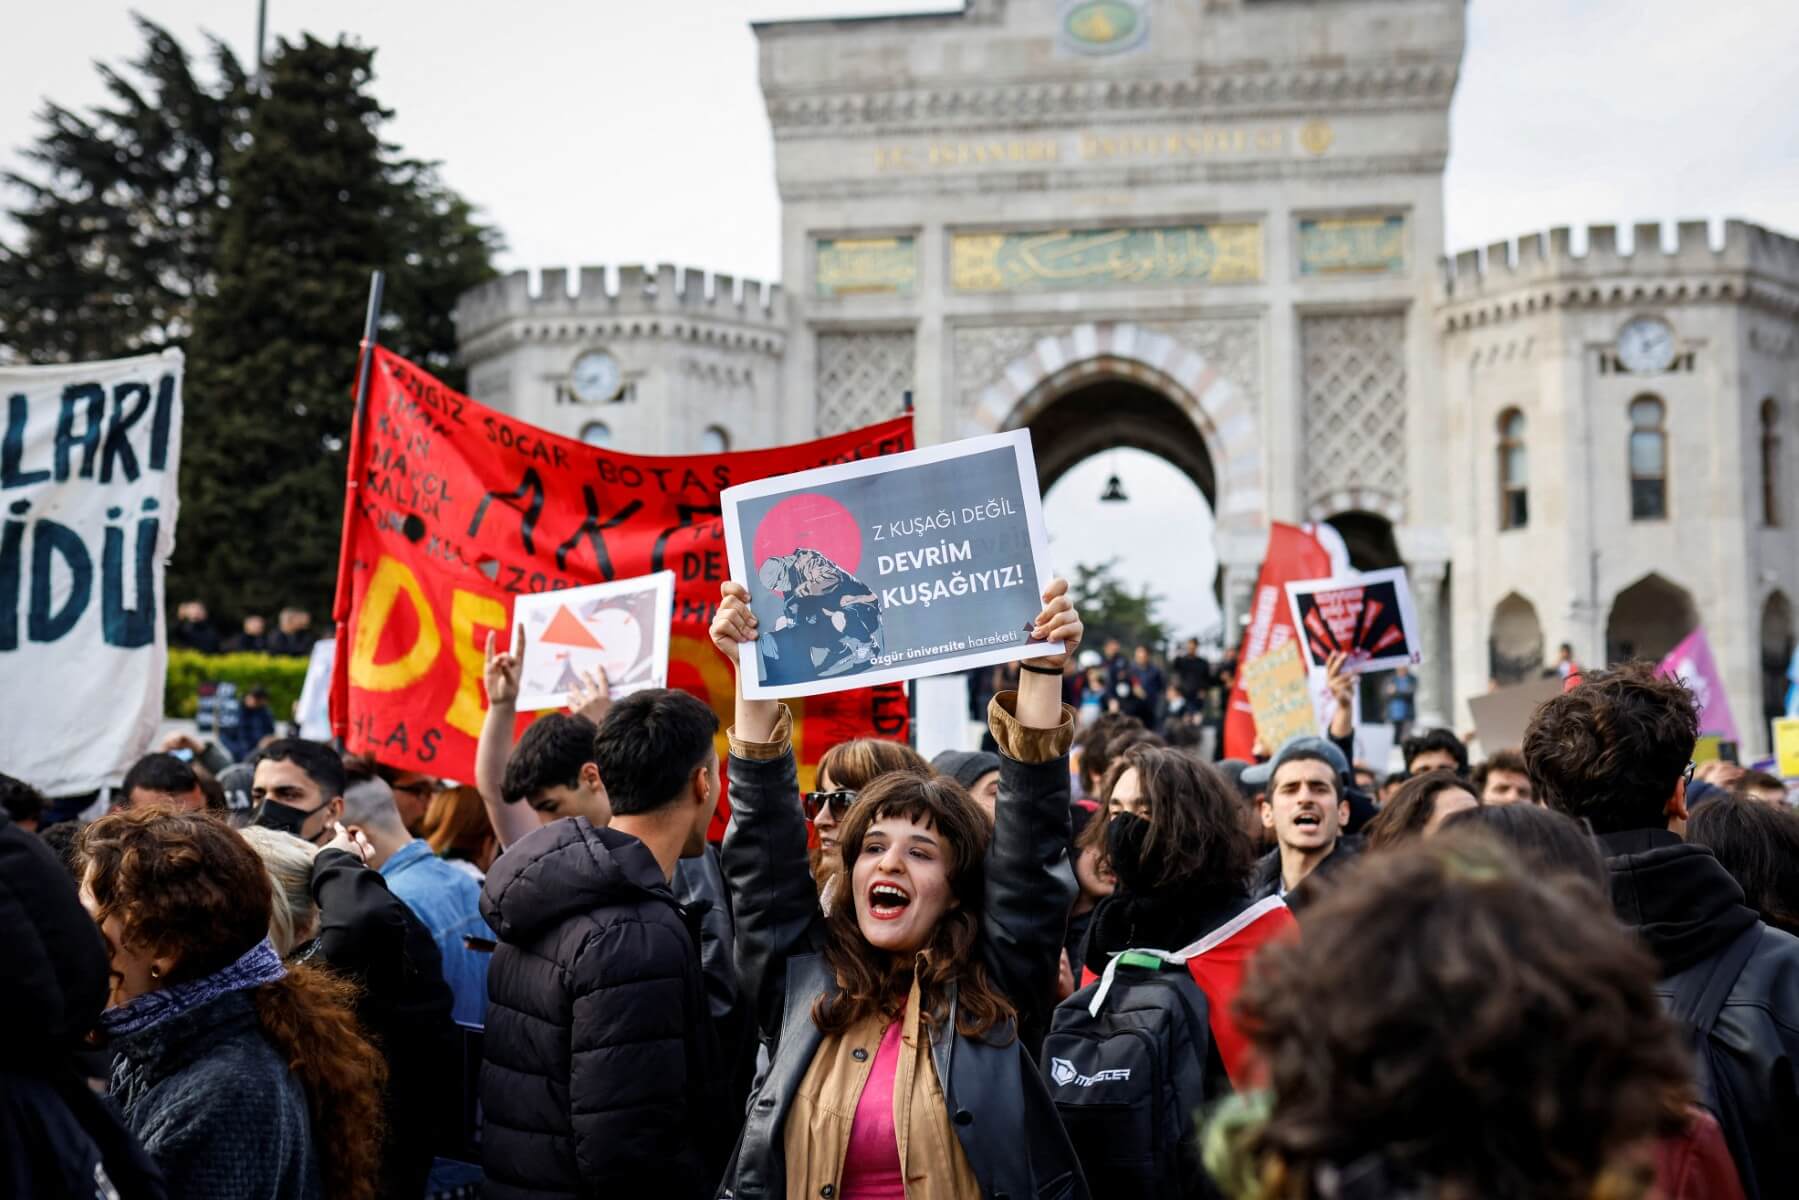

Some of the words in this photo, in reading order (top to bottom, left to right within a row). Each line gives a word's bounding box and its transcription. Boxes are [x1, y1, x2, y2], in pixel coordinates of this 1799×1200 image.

[1, 374, 175, 490] LARI
[483, 416, 572, 471] SOCAR
[873, 525, 885, 541] Z
[890, 510, 957, 537] KUŞAĞI
[961, 497, 1017, 524] DEĞİL
[877, 539, 973, 576] DEVRİM
[881, 564, 1025, 609] KUŞAĞIYIZ!
[906, 642, 966, 660] üniversite
[968, 630, 1018, 648] hareketi
